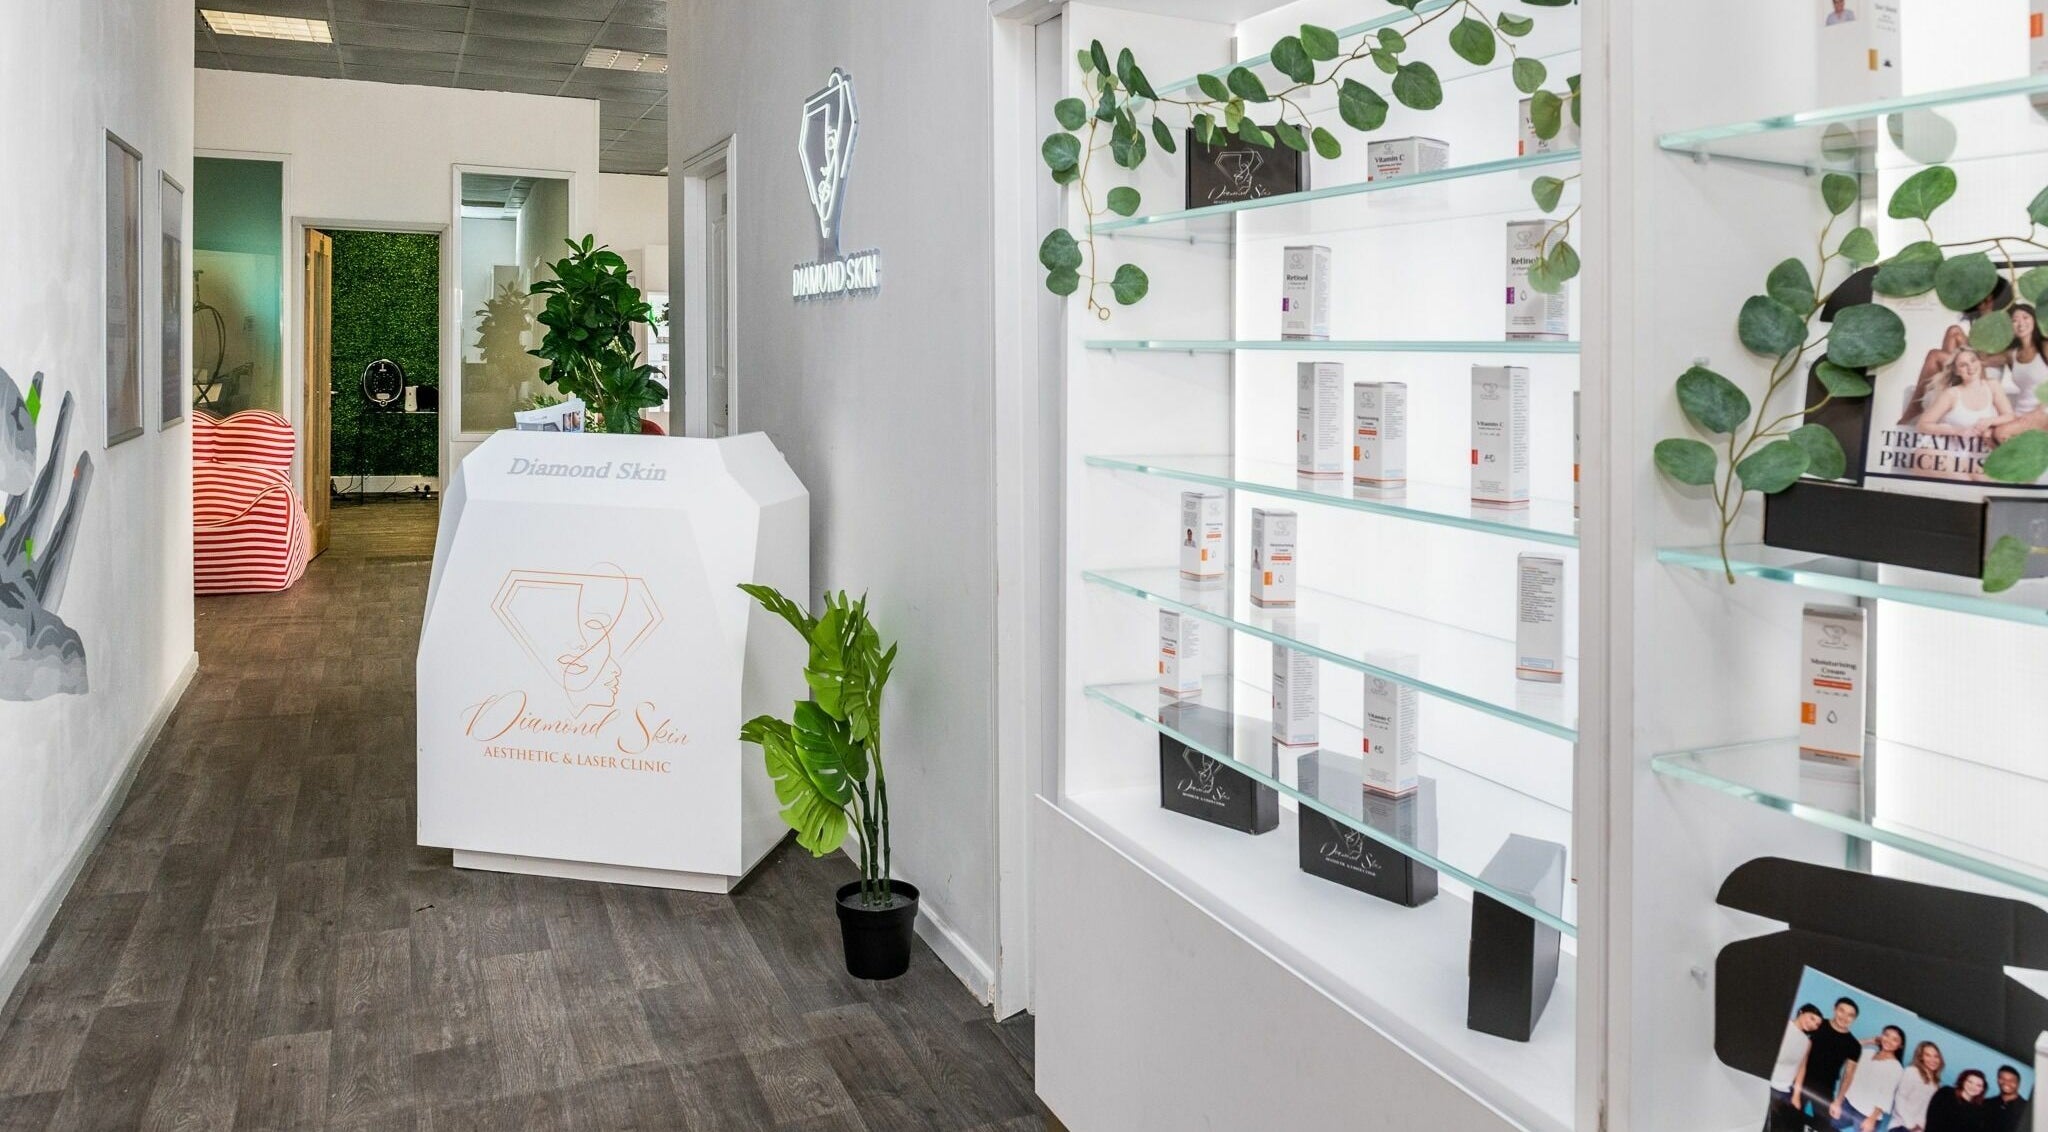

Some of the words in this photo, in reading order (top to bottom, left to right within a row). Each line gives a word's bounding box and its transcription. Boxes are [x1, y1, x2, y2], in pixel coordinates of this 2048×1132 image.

[793, 260, 845, 297] DIAMOND
[846, 254, 877, 290] SKIN
[1881, 430, 1992, 453] TREATME
[507, 457, 611, 479] Diamond
[616, 461, 667, 482] Skin
[1880, 450, 1947, 471] PRICE
[1953, 456, 1985, 474] LIS
[461, 690, 620, 742] Diamond
[616, 701, 690, 755] Skin
[484, 746, 559, 763] AESTHETIC
[562, 752, 573, 765] &
[577, 754, 617, 769] LASER
[621, 758, 672, 774] CLINIC
